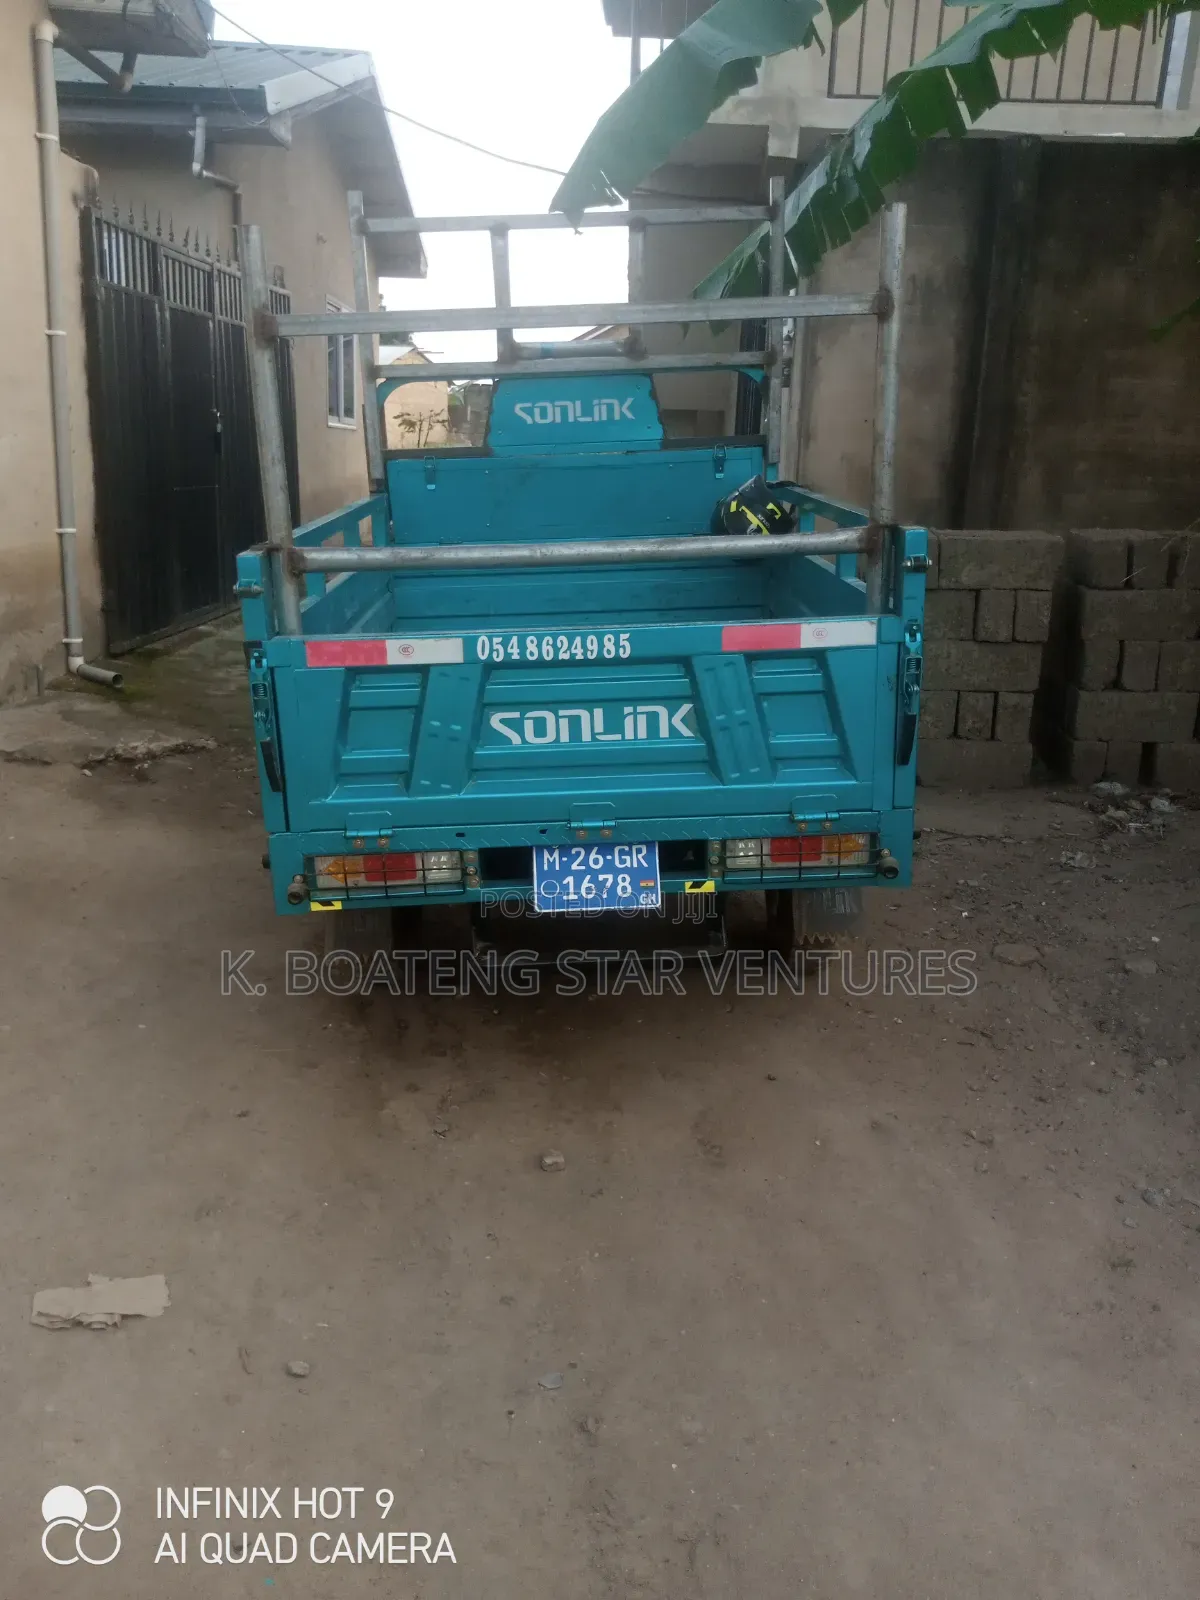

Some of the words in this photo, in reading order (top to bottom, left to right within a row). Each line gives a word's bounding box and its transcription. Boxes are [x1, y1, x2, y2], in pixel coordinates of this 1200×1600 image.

[514, 397, 636, 425] SONLINK
[476, 633, 632, 662] 0548624985
[489, 703, 696, 745] SONLINK
[543, 845, 649, 871] M-26-GR
[562, 874, 632, 900] 1678
